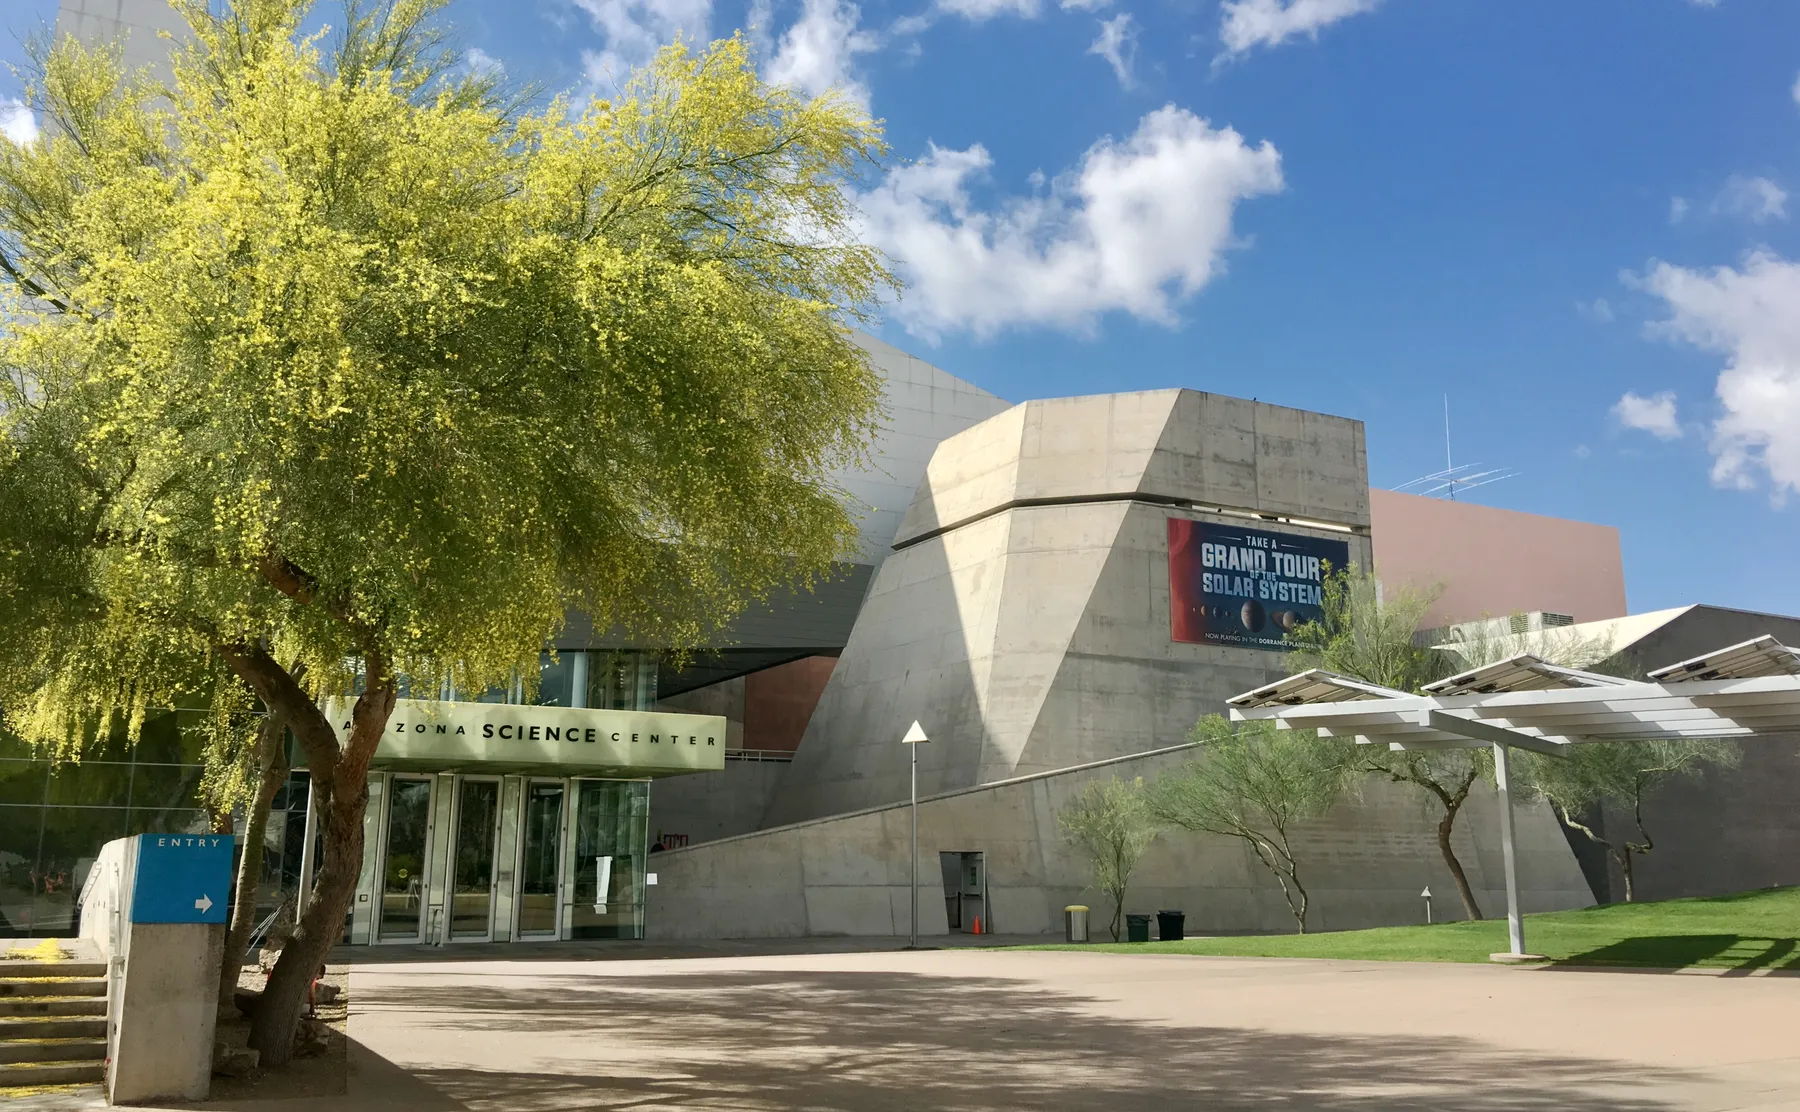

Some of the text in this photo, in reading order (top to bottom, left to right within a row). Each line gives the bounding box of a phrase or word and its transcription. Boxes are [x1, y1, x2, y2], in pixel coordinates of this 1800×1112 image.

[1246, 536, 1277, 549] TAKE A
[1201, 542, 1320, 581] GRAND TOUR
[1249, 569, 1276, 581] OF THE
[1202, 572, 1321, 606] SOLAR SYSTEM
[1205, 632, 1219, 640] NOW
[1220, 634, 1241, 643] PLAYING
[1258, 638, 1287, 647] DORRANCE
[343, 721, 715, 746] AZONA SCIENCE CENTER
[158, 838, 219, 847] ENTRY
